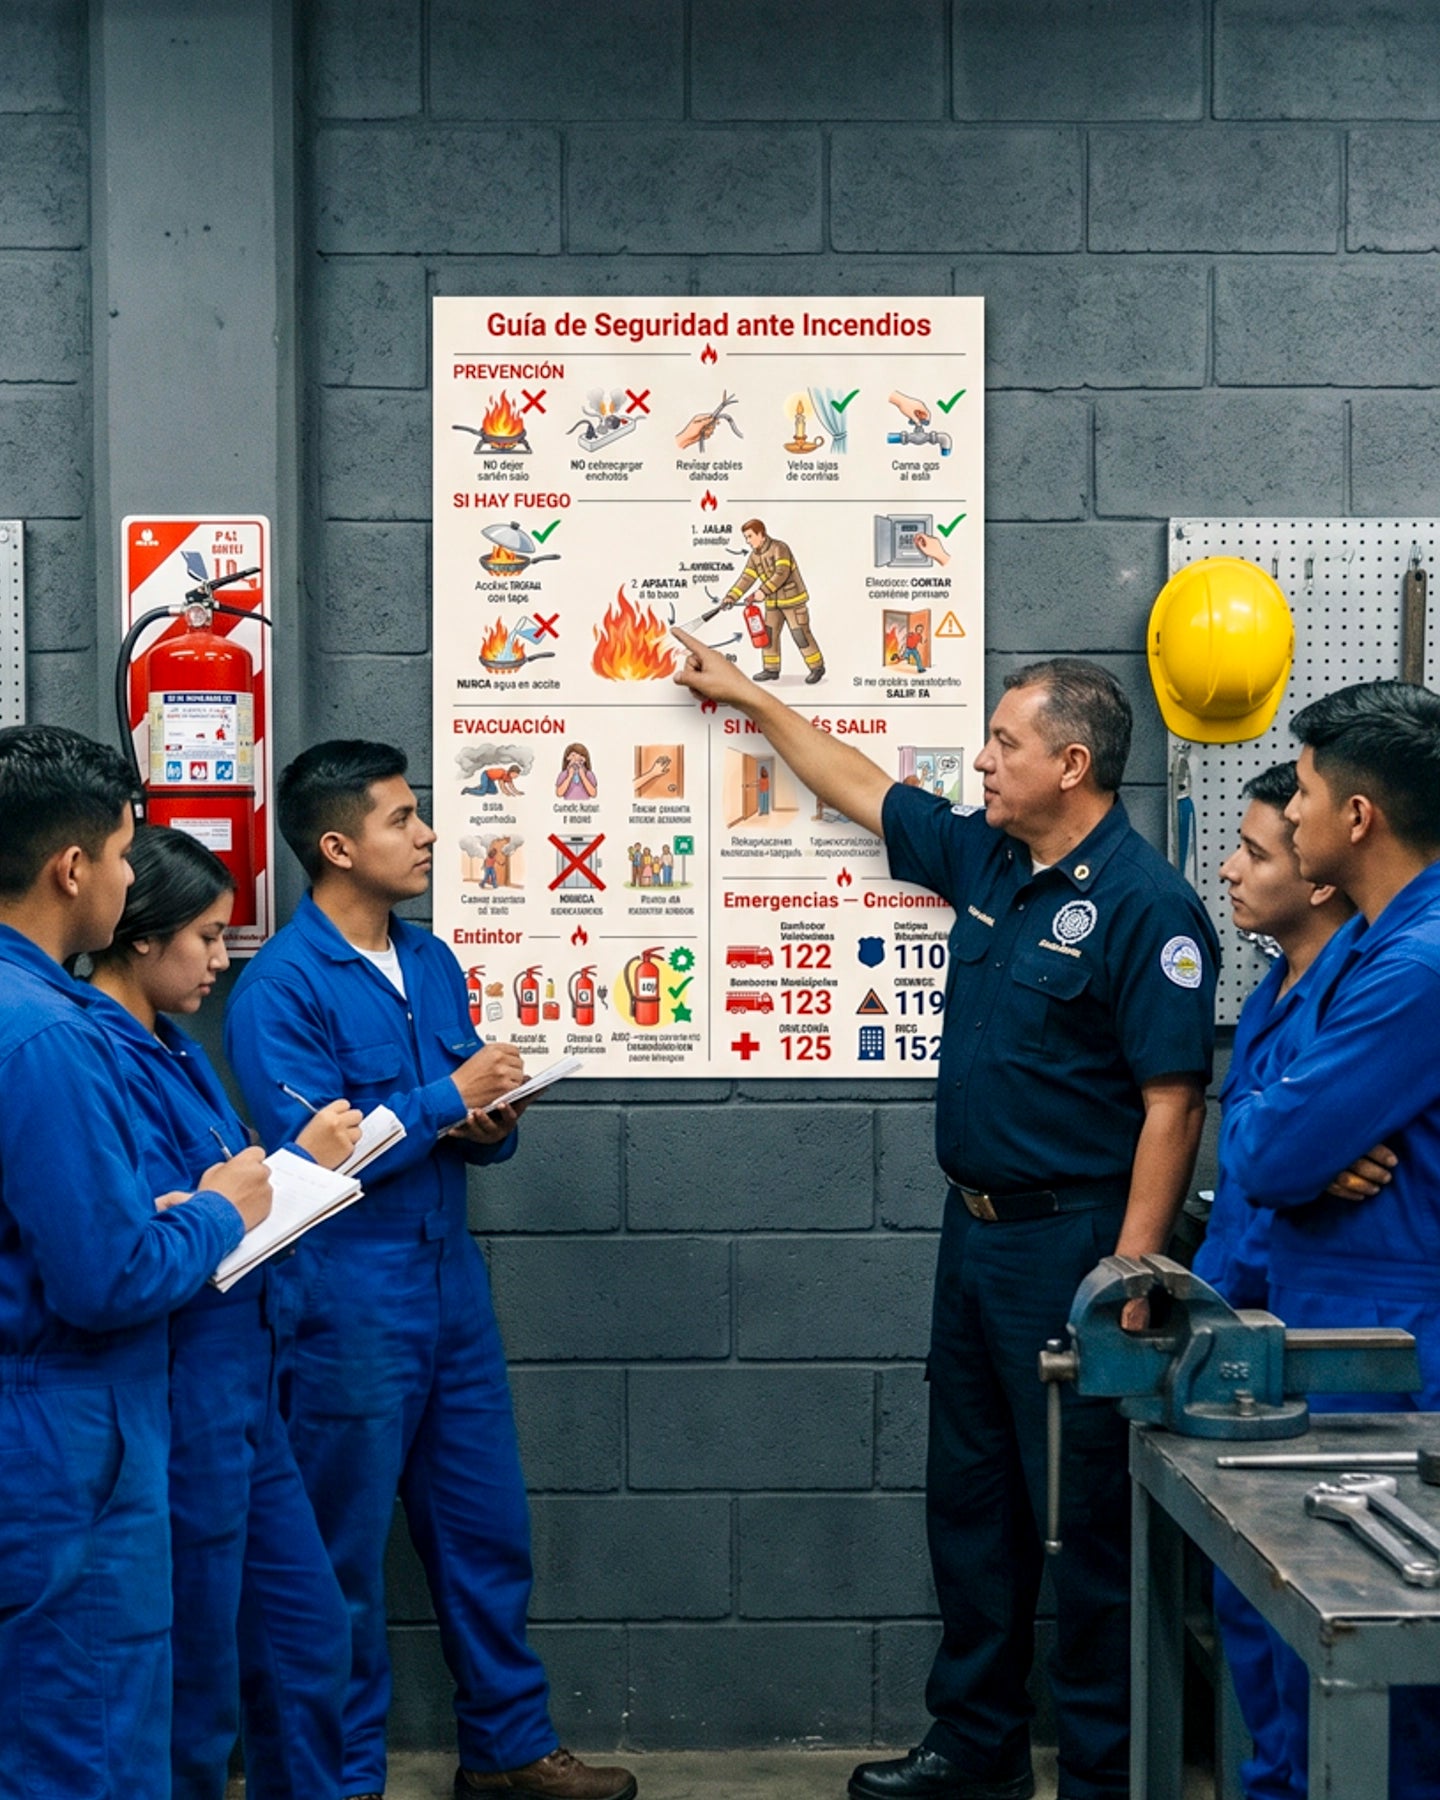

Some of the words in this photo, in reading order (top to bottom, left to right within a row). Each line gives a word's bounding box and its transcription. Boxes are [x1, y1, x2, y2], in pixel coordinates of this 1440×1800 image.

[488, 313, 546, 336] Guía
[555, 312, 586, 336] de
[595, 312, 728, 342] Seguridad
[737, 315, 794, 336] ante
[804, 312, 931, 336] Incendios
[454, 361, 564, 379] PREVENCIÓN
[484, 460, 497, 470] NO
[571, 459, 585, 470] NO
[454, 493, 469, 508] SI
[475, 493, 509, 507] HAY
[515, 493, 570, 508] FUEGO
[454, 716, 564, 734] EVACUACIÓN
[725, 719, 740, 733] SI
[837, 719, 886, 734] SALIR
[724, 892, 838, 911] Emergencias
[781, 944, 831, 968] 122
[895, 944, 945, 969] 110
[781, 990, 831, 1014] 123
[896, 989, 946, 1016] 119
[781, 1036, 831, 1060] 125
[895, 1035, 944, 1061] 152
